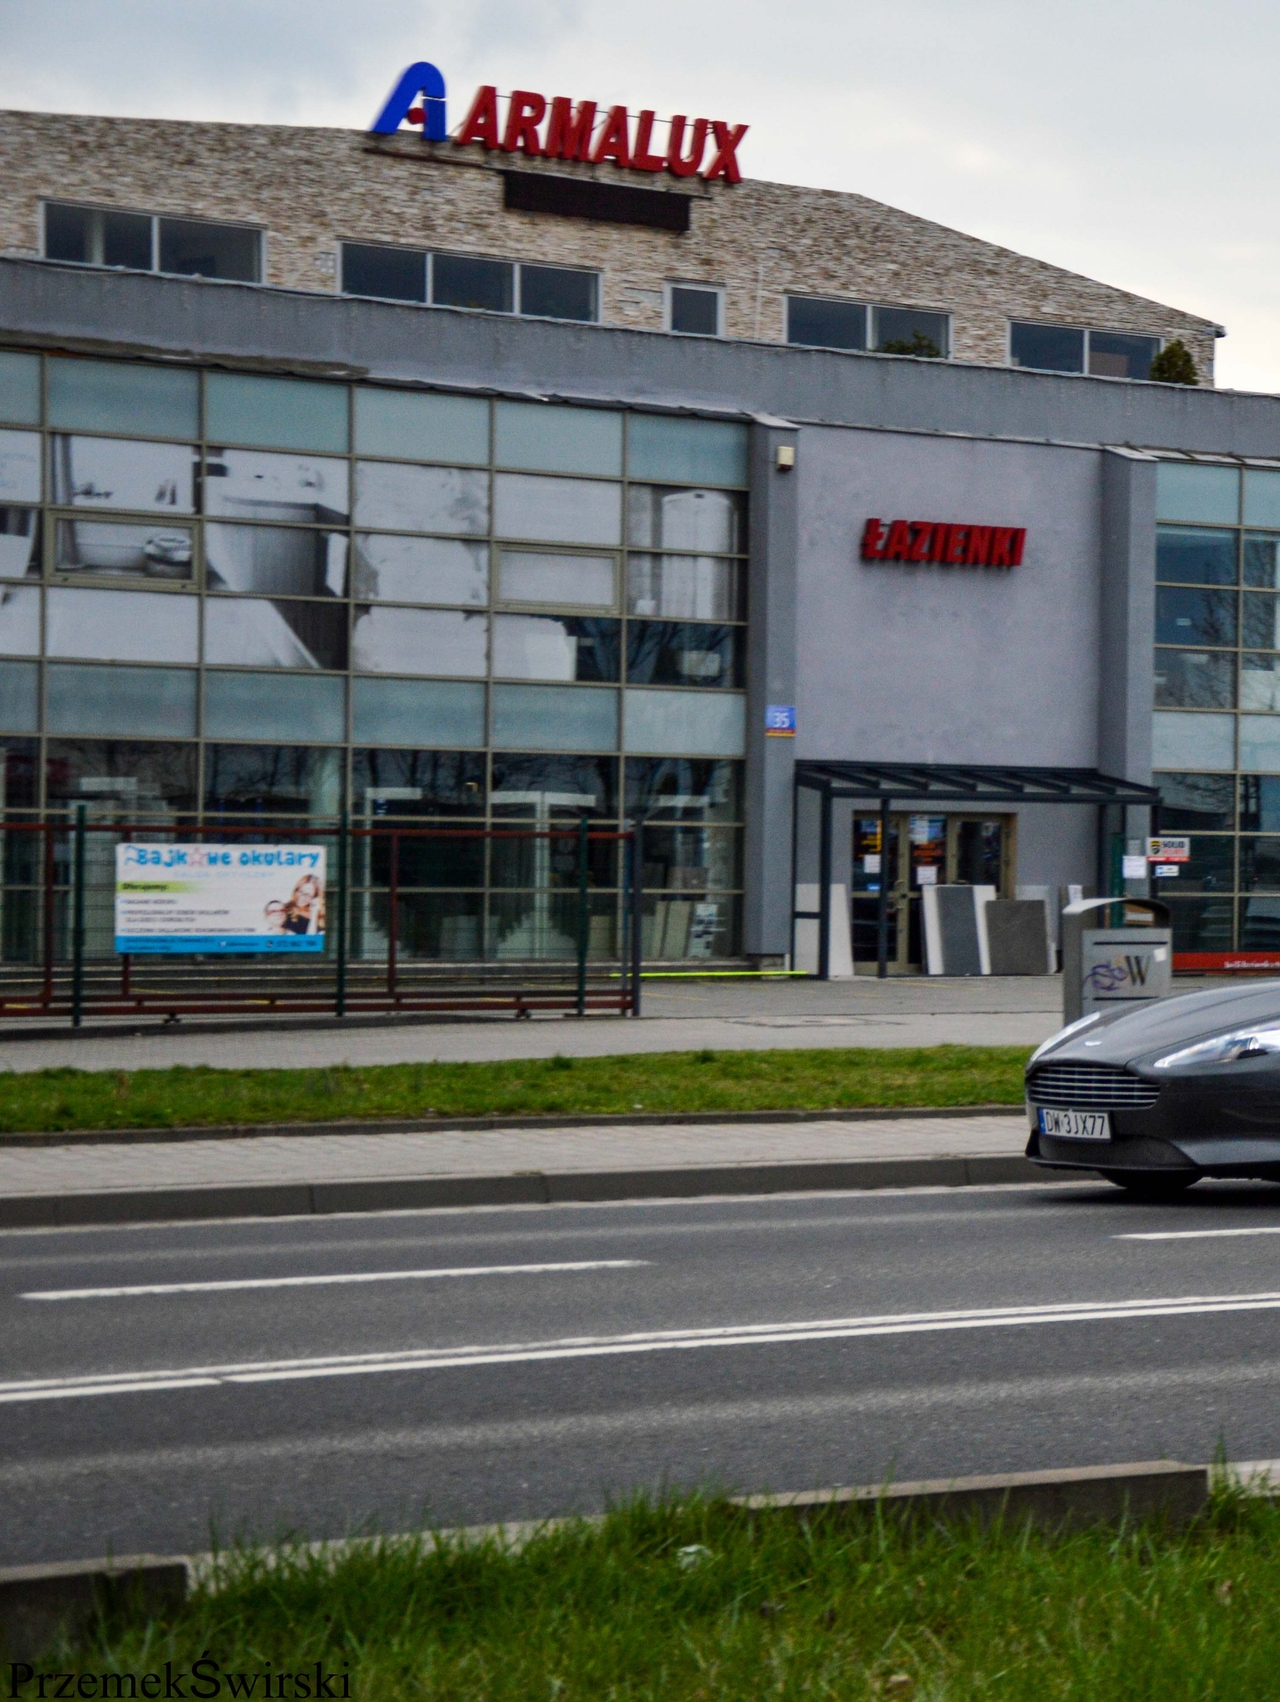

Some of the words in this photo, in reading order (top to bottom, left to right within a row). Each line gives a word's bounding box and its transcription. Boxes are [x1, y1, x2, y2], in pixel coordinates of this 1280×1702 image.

[457, 85, 750, 184] ARMALUX
[861, 518, 1027, 566] ŁAZIENKI
[773, 712, 790, 728] 35
[239, 850, 321, 868] okulary
[1063, 1113, 1105, 1136] 3JX77
